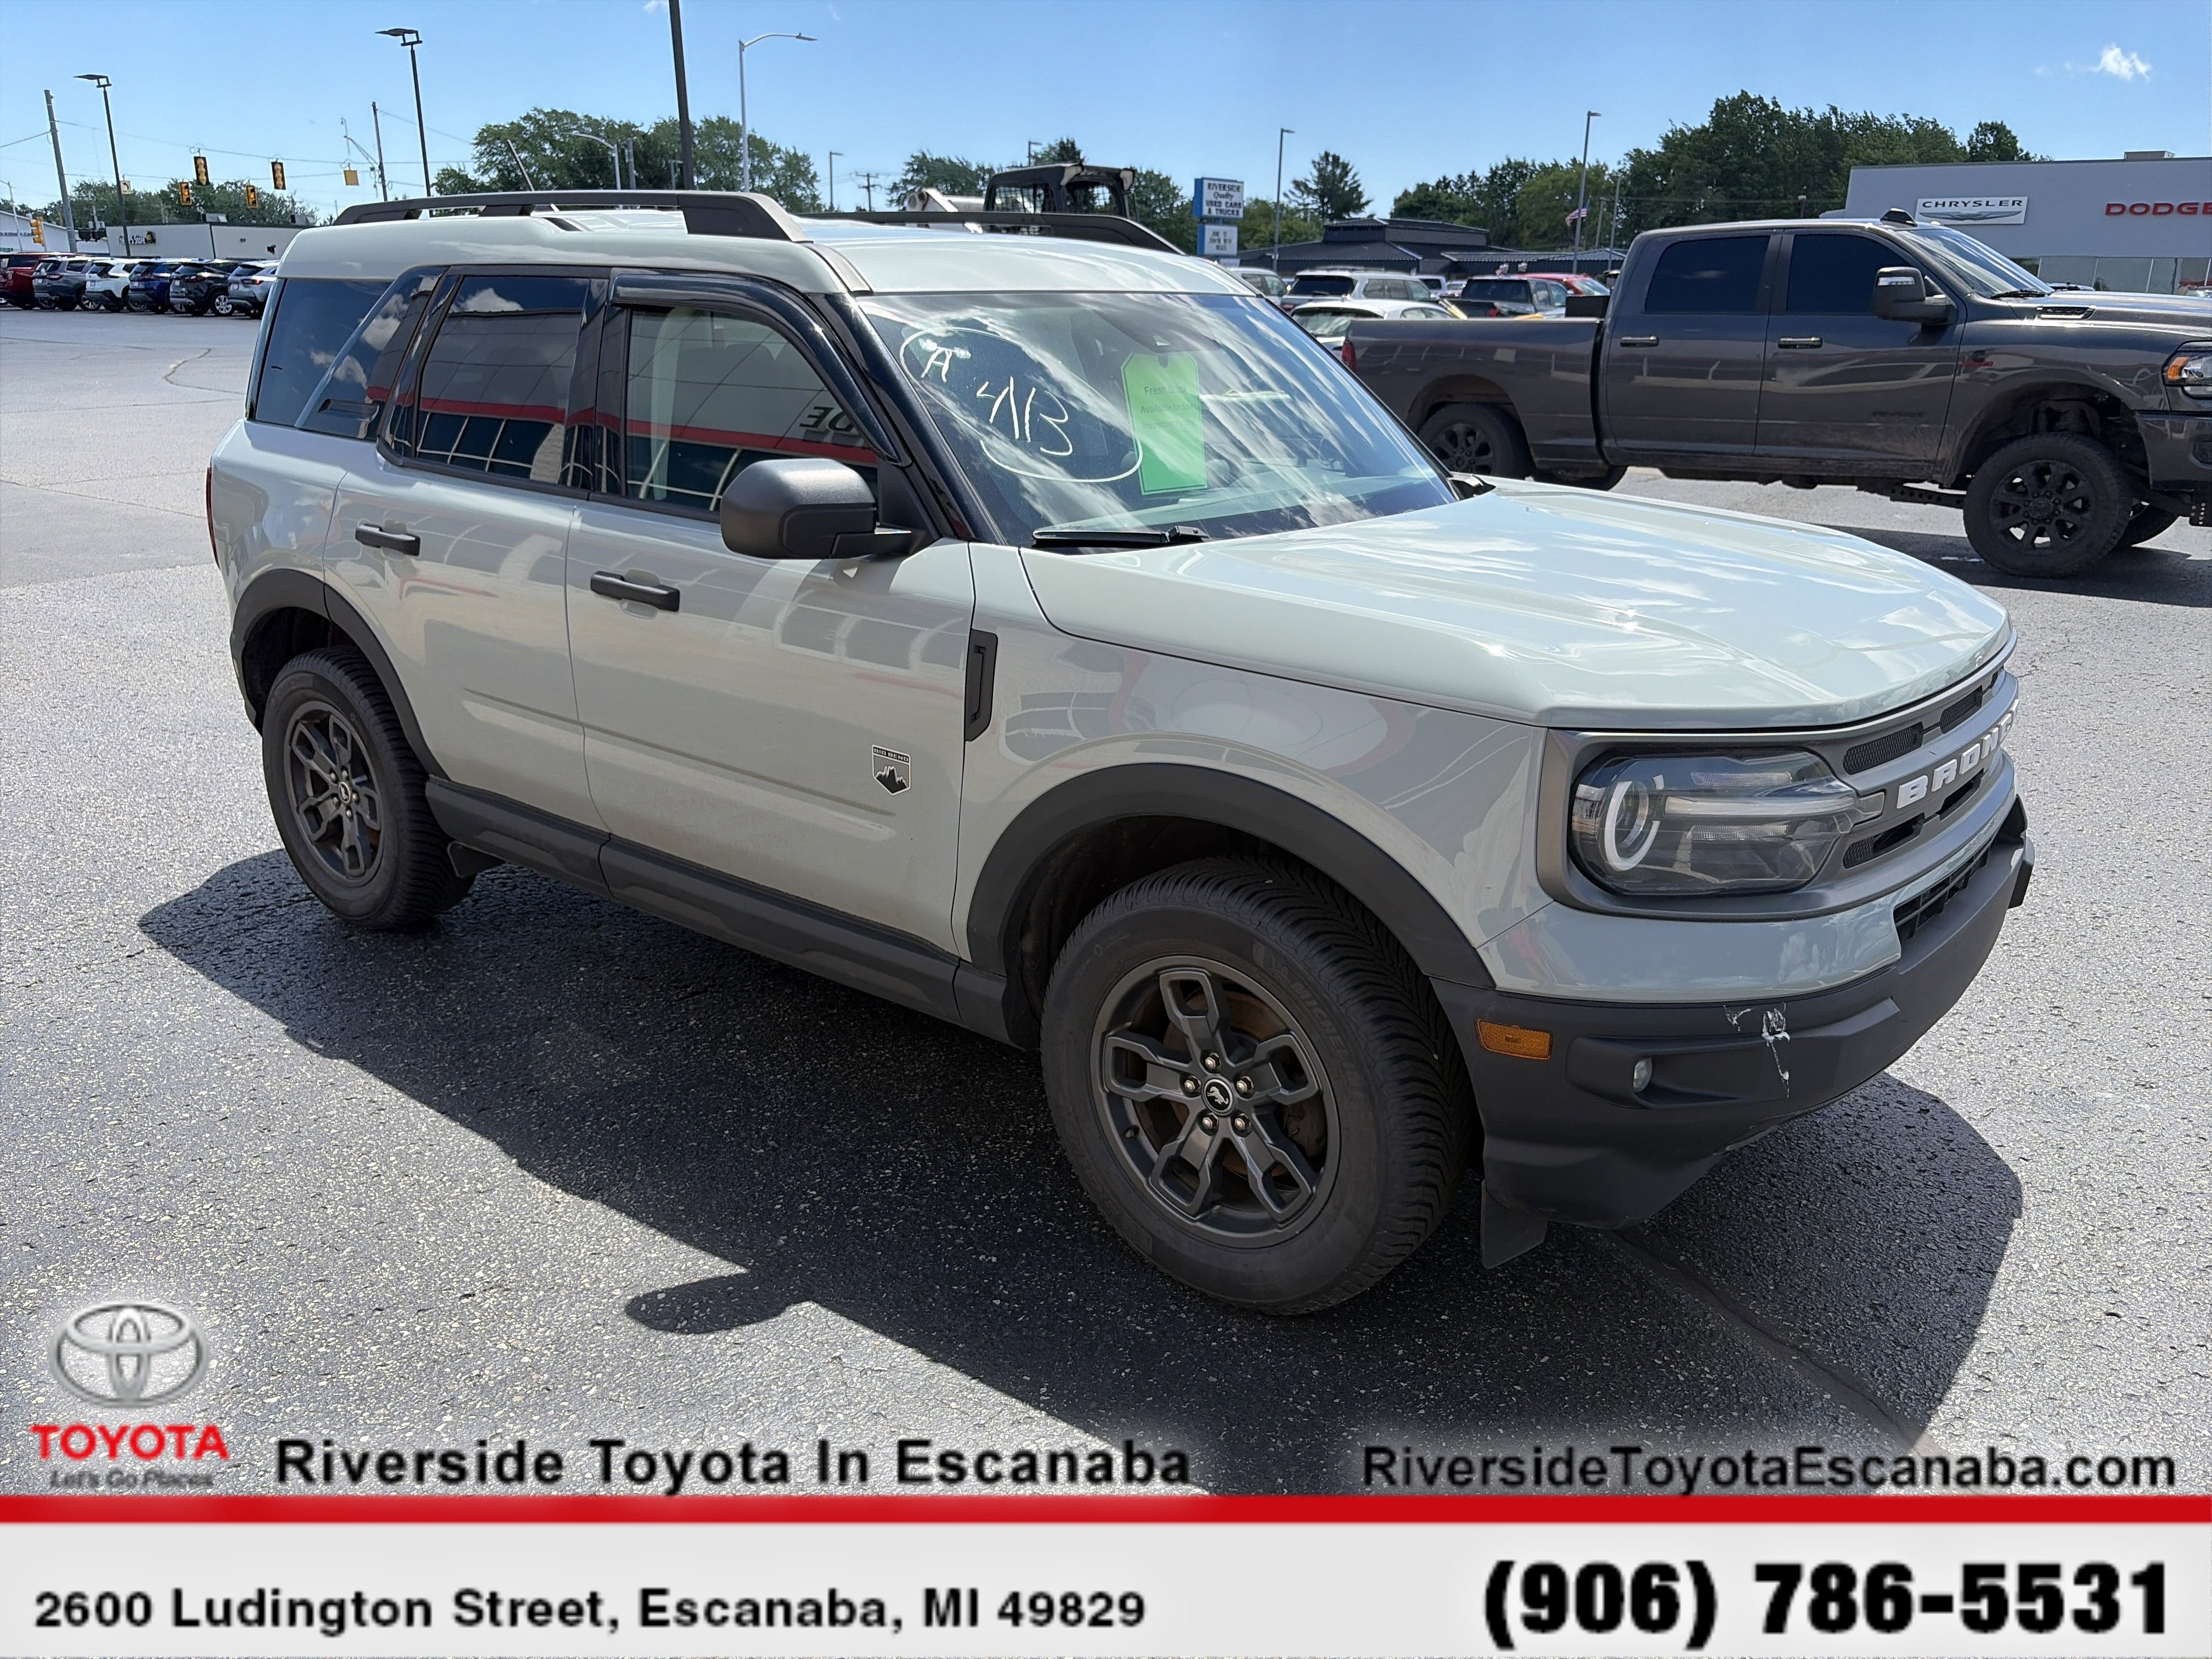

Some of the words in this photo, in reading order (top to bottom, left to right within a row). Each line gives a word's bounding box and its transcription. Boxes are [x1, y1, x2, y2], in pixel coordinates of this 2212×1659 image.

[1144, 385, 1167, 396] Fresh
[874, 748, 887, 756] BIG
[888, 752, 909, 762] BEND
[1897, 699, 2019, 809] BRONC
